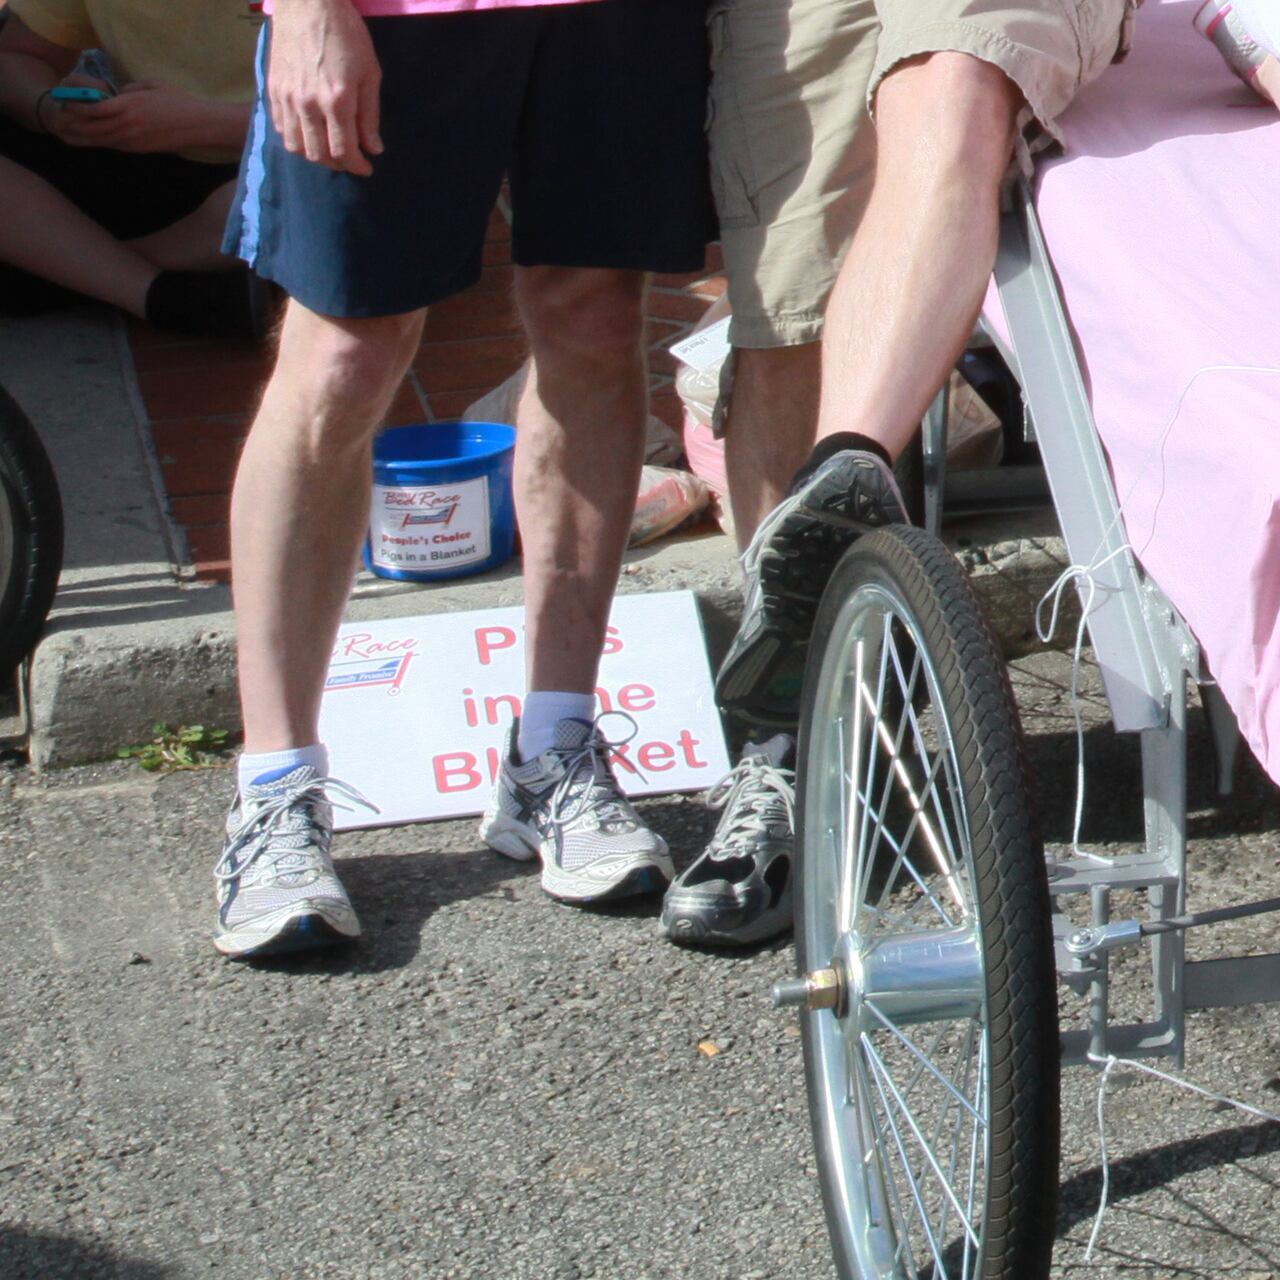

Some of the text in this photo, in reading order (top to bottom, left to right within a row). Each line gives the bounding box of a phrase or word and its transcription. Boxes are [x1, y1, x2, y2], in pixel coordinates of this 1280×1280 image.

[418, 491, 461, 507] Race
[432, 532, 472, 543] Choice
[405, 552, 417, 561] in
[420, 553, 427, 561] a
[430, 545, 476, 560] Blanket
[341, 633, 419, 659] Race
[474, 625, 624, 665] Ps
[461, 688, 522, 727] in
